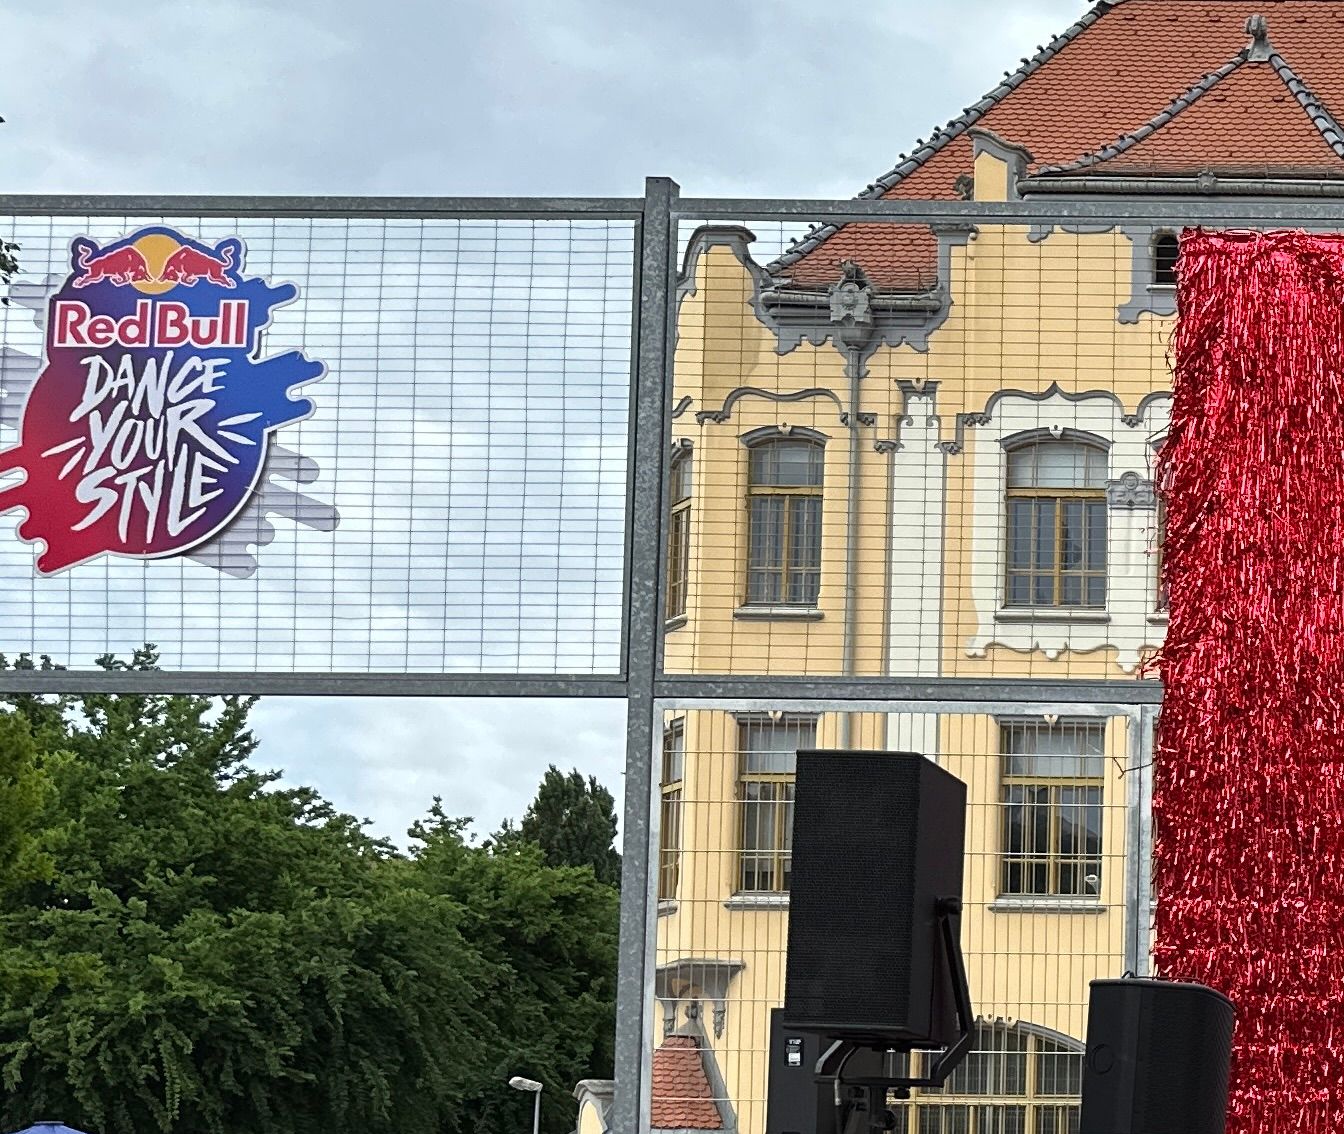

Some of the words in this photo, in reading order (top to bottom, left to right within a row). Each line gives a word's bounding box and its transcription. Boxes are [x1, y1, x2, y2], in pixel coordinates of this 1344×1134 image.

[56, 300, 150, 347] Red
[155, 300, 248, 347] Bull
[70, 351, 231, 422] DANCE
[83, 399, 240, 475] YOUR
[71, 444, 229, 543] STYLE
